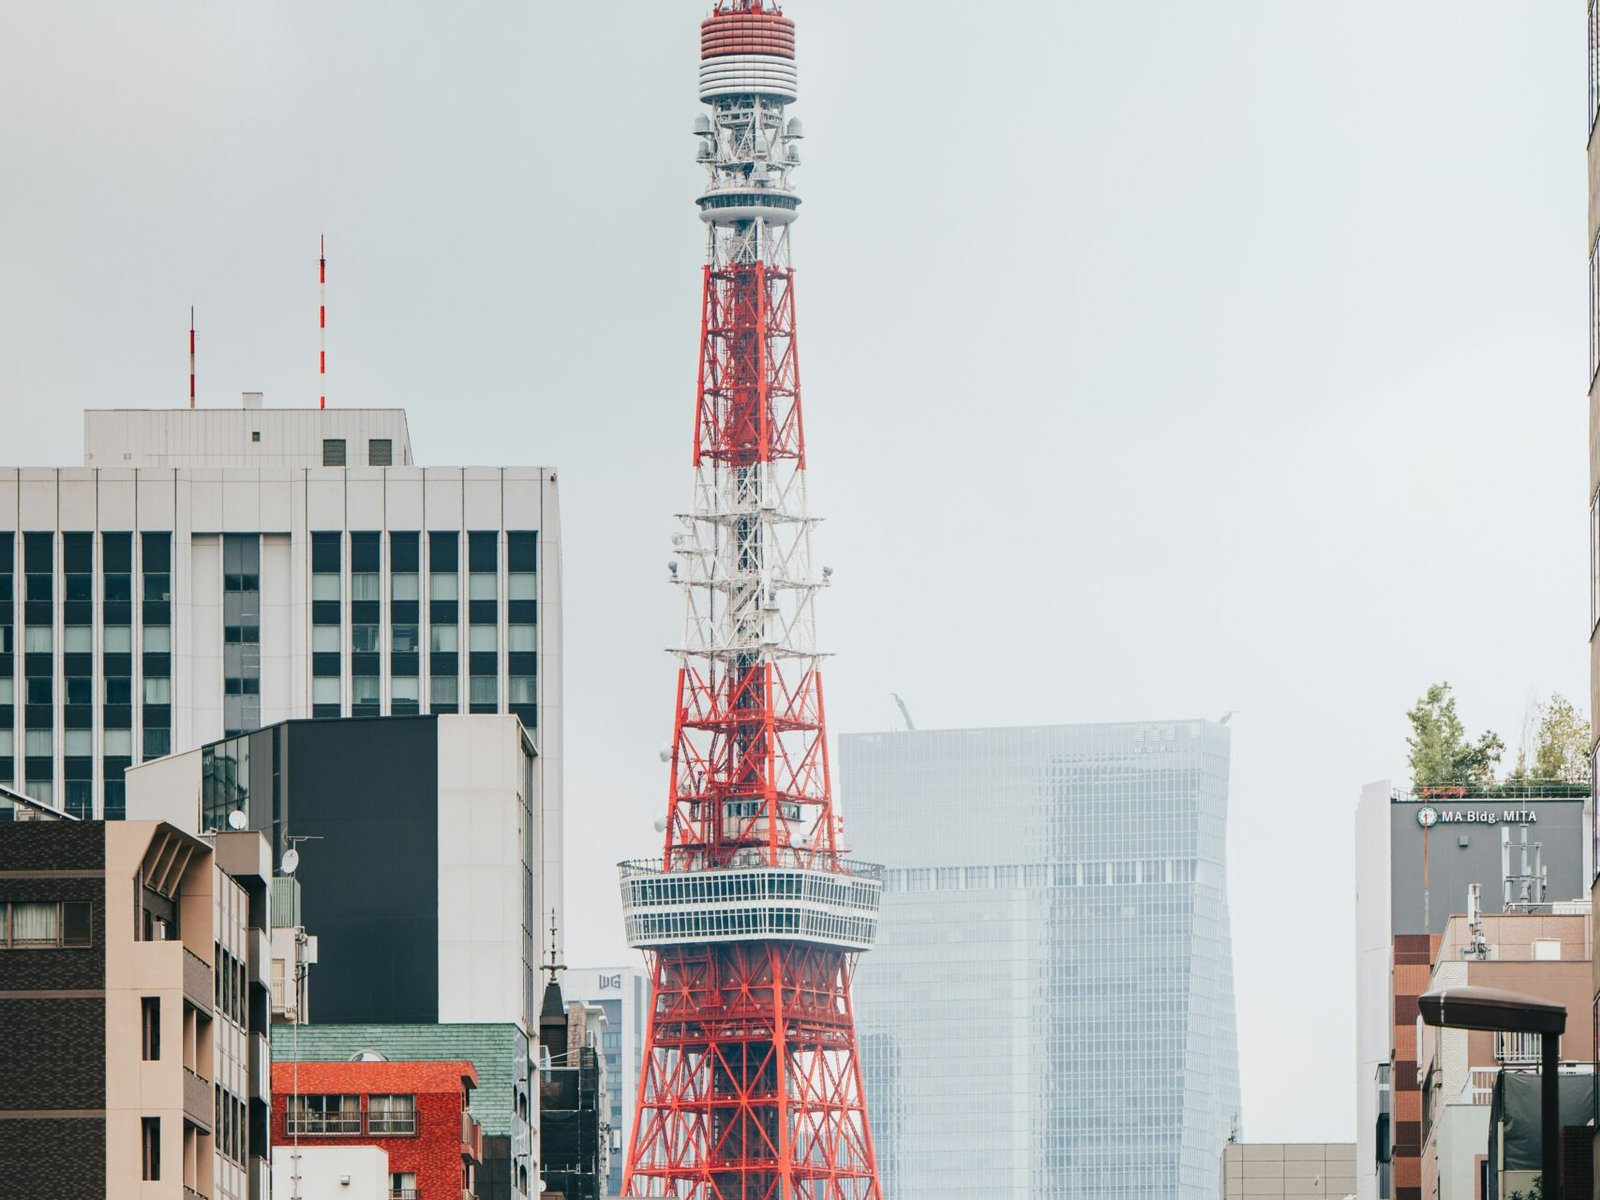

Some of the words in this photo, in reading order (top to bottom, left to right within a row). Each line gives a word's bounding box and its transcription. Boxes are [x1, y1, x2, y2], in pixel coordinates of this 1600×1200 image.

[1441, 811, 1463, 822] MA
[1467, 810, 1499, 824] Bldg.
[1504, 811, 1537, 822] MITA
